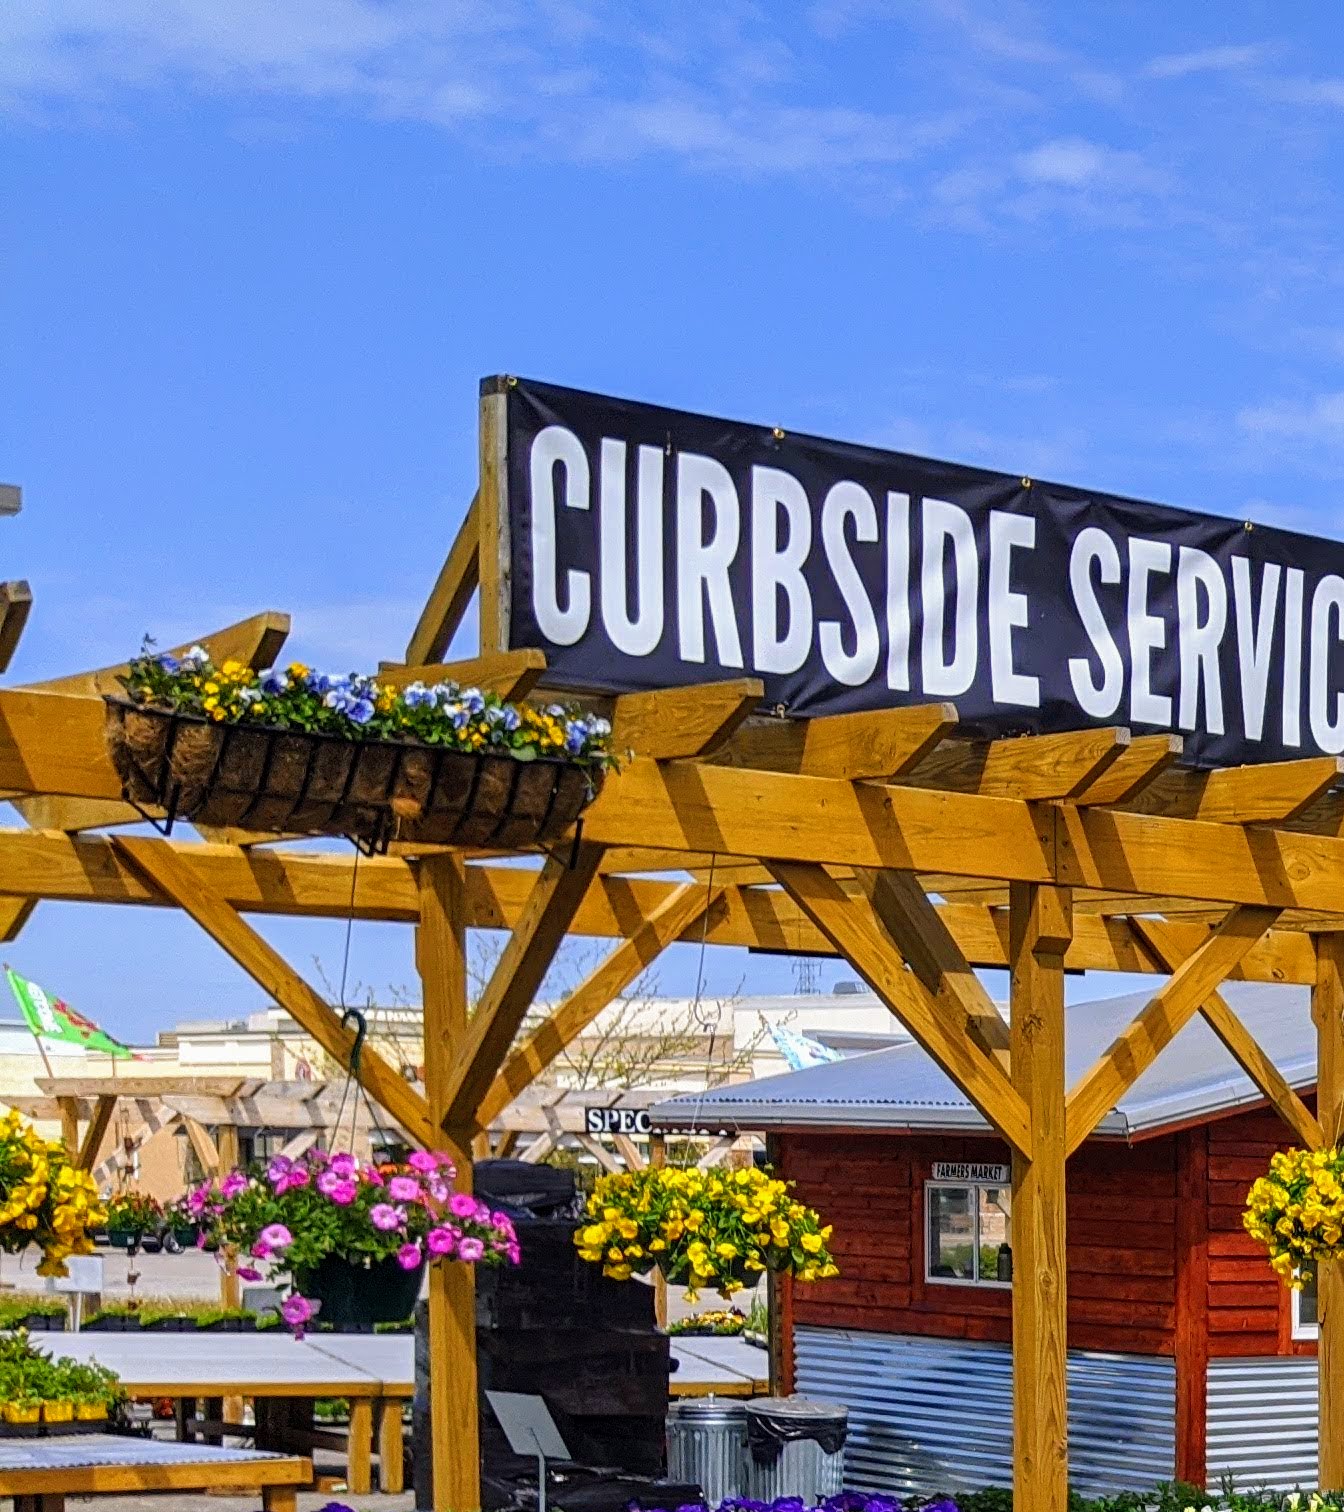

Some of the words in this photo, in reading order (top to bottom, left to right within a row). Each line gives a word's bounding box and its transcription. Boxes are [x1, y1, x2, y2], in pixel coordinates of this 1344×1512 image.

[529, 425, 1040, 708] CURBSIDE
[936, 1163, 969, 1178] FARMERS
[970, 1164, 1002, 1180] MARKET
